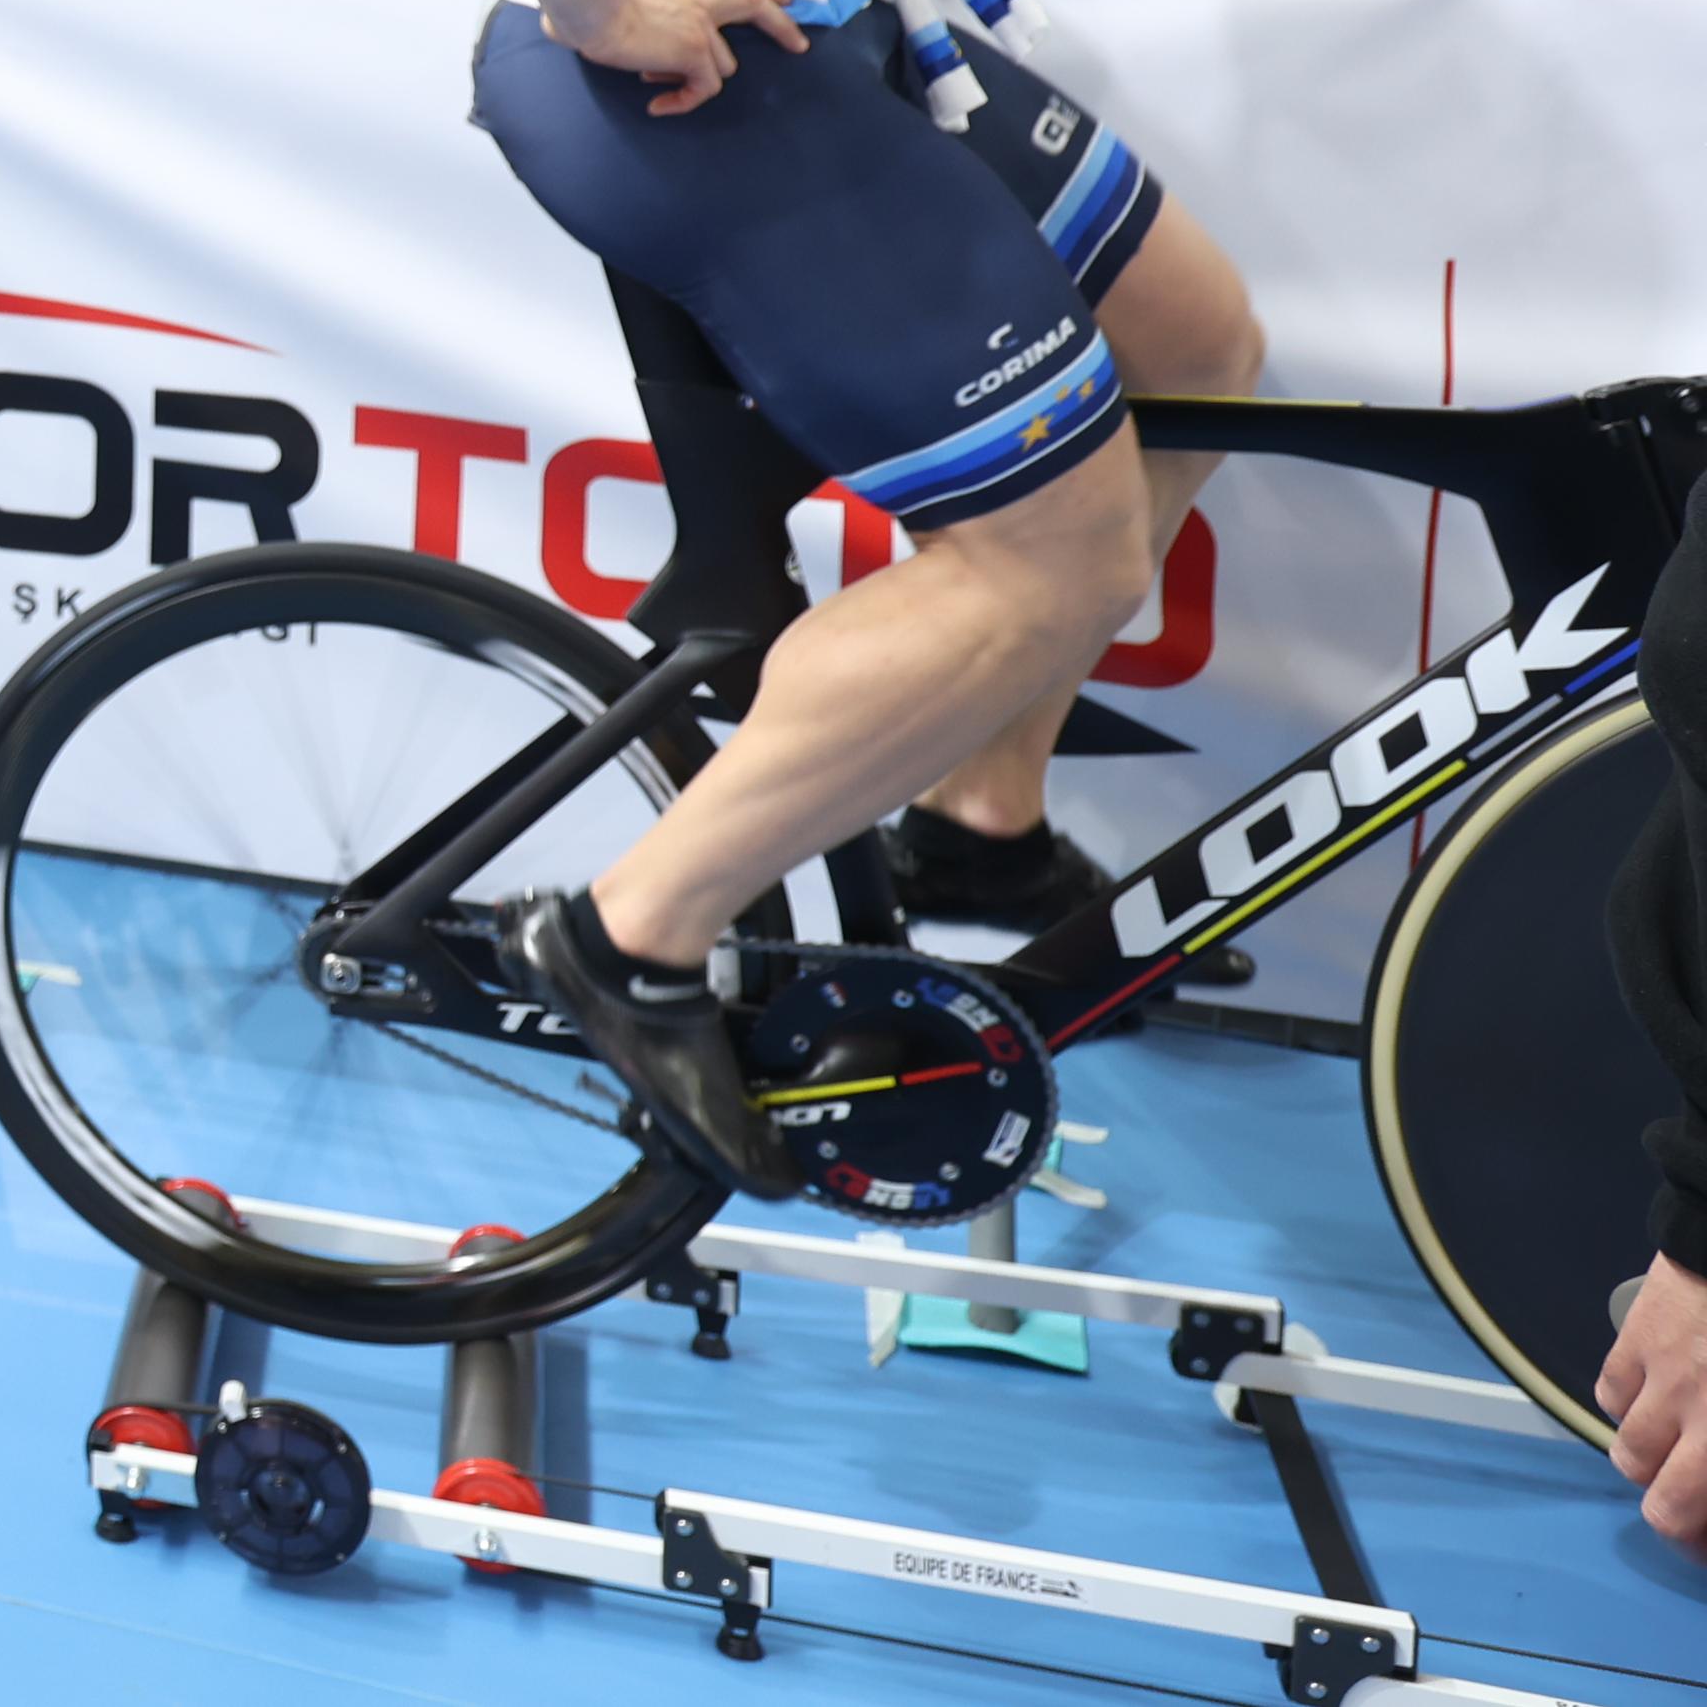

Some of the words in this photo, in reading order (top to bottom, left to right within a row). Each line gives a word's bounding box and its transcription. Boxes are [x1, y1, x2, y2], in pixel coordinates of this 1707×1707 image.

[954, 316, 1077, 408] CORIMA
[1110, 561, 1629, 958] LOOK
[894, 1552, 947, 1579] EQUIPE
[951, 1561, 972, 1583] DE
[975, 1565, 1037, 1594] FRANCE
